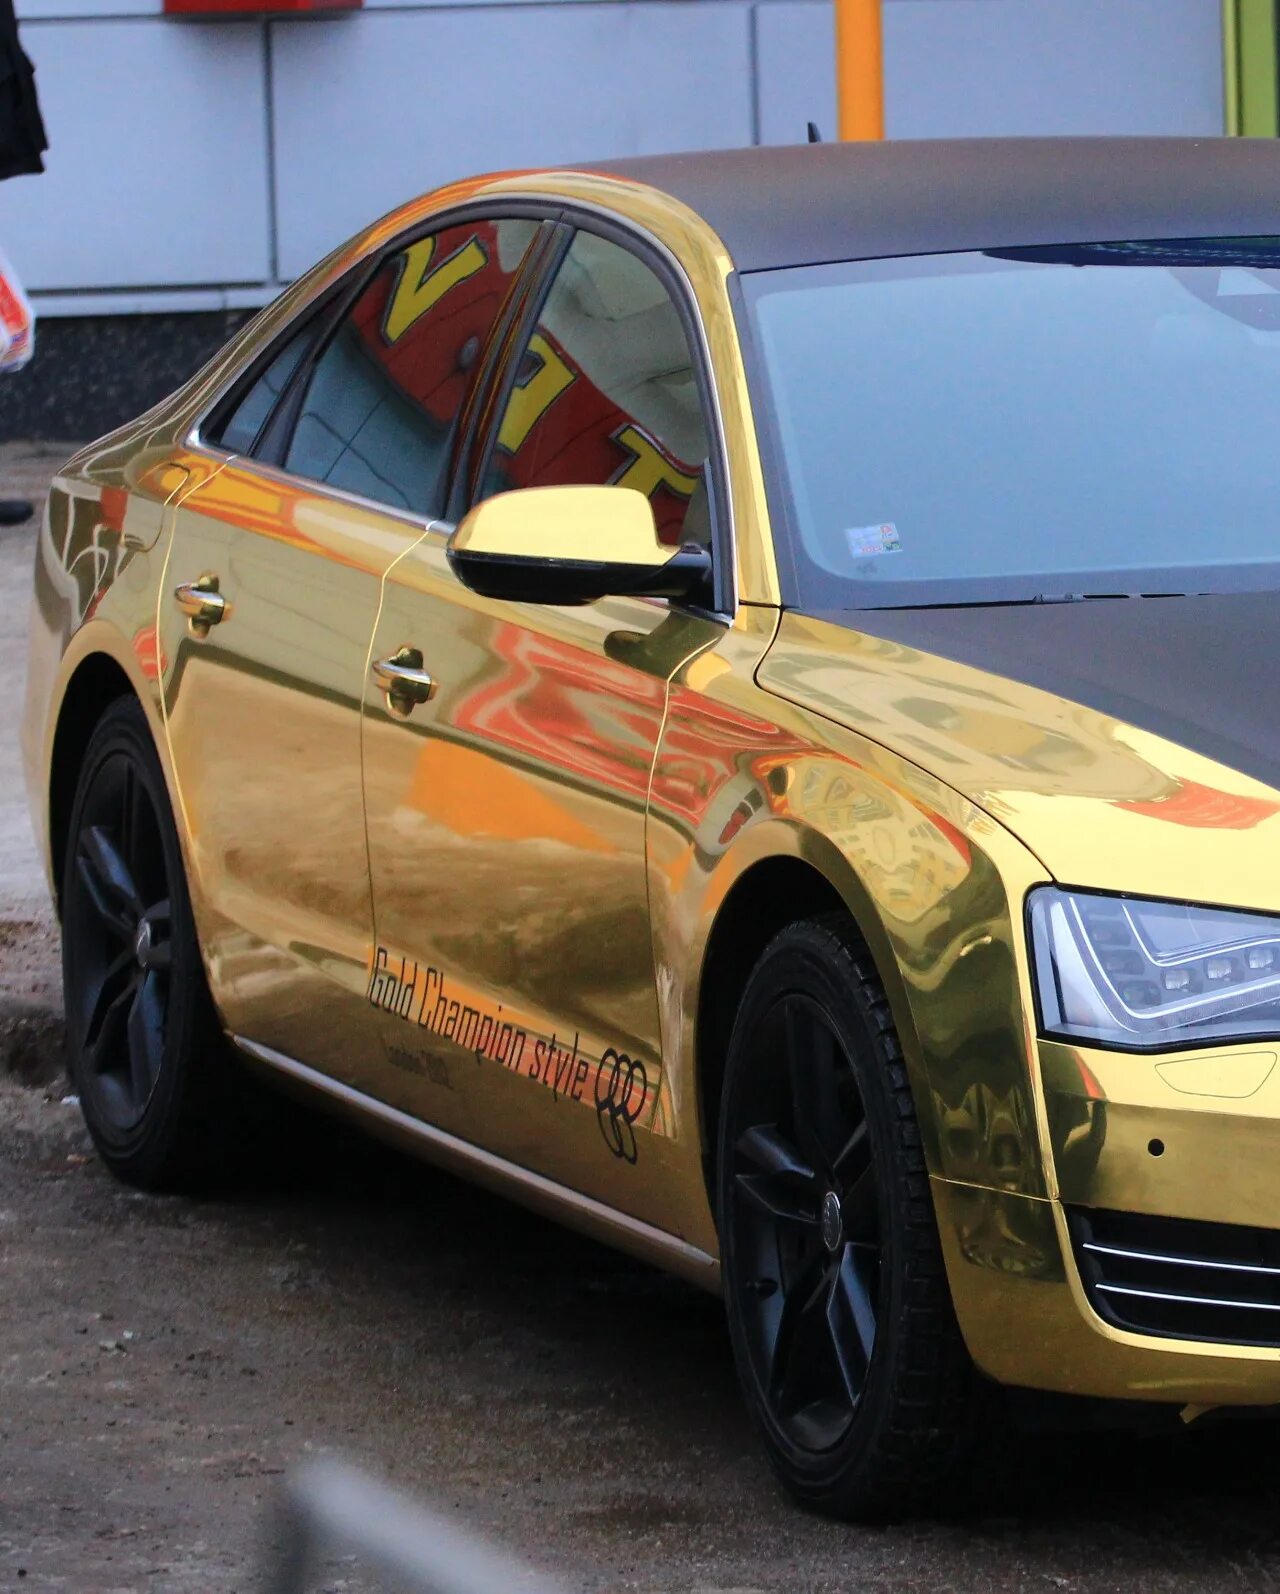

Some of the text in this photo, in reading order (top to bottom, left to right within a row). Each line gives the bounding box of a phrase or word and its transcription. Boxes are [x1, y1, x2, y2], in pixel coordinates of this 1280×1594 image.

[368, 946, 418, 1021] Gold
[417, 967, 527, 1066] Champion
[528, 1031, 590, 1103] style
